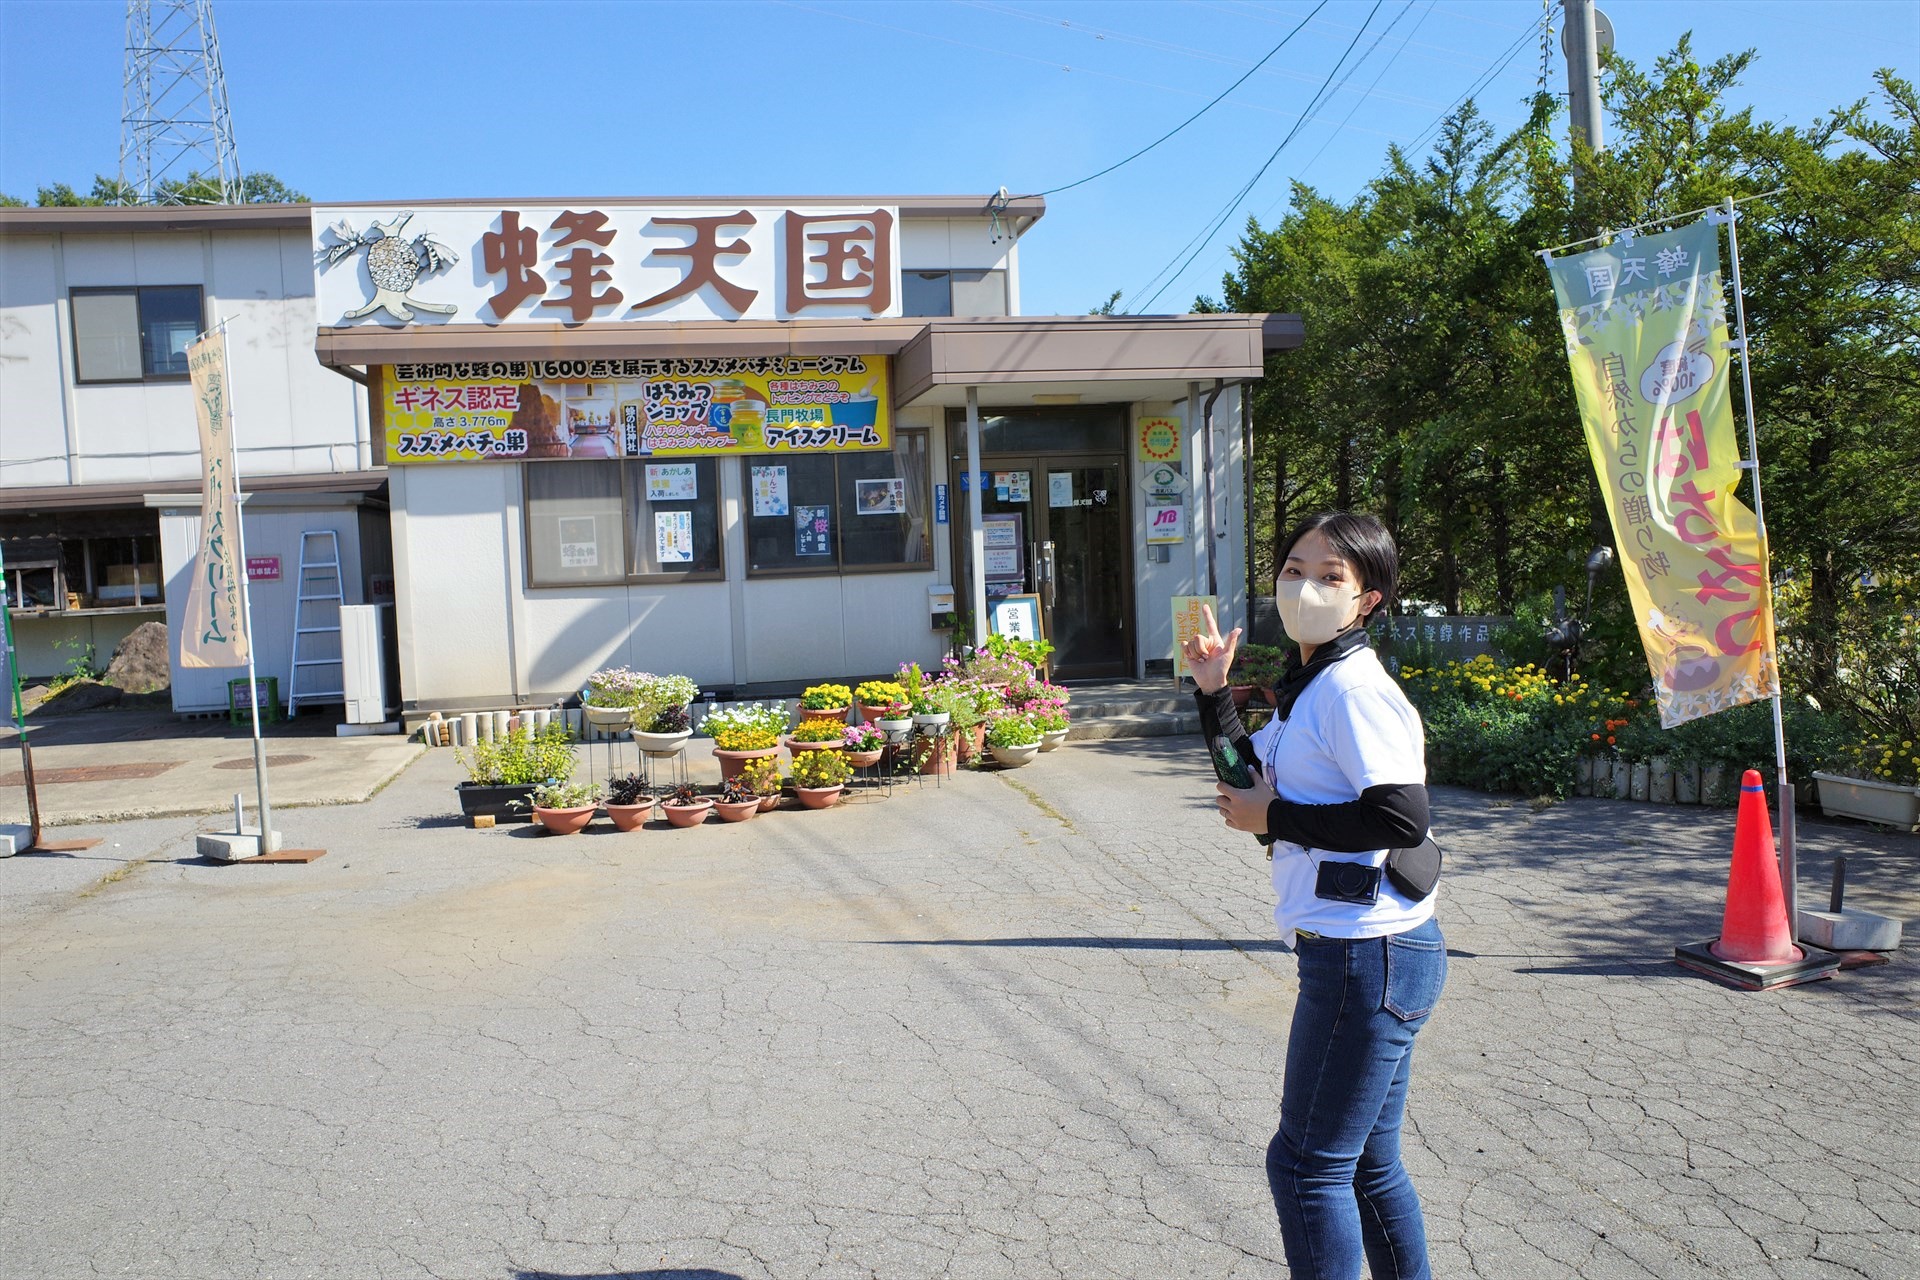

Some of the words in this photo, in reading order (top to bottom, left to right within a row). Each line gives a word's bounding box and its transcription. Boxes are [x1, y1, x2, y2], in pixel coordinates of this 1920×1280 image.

[483, 208, 893, 321] 蜂天国
[646, 383, 710, 400] はちみつ
[770, 380, 838, 391] 各種はちみつの
[395, 385, 518, 411] ギネス認定
[772, 393, 848, 403] トッピングでどうぞ
[647, 402, 709, 420] ショップ
[766, 408, 824, 423] 長門牧場
[433, 417, 455, 427] 高さ
[460, 416, 506, 427] 3.776m
[647, 425, 717, 436] ハチのクッキー
[768, 427, 879, 445] アイスクリーム
[400, 431, 526, 453] スズメバチの巣
[648, 436, 737, 448] はちみつシャンプー
[661, 467, 692, 476] あかしあ
[1153, 509, 1177, 526] JTB
